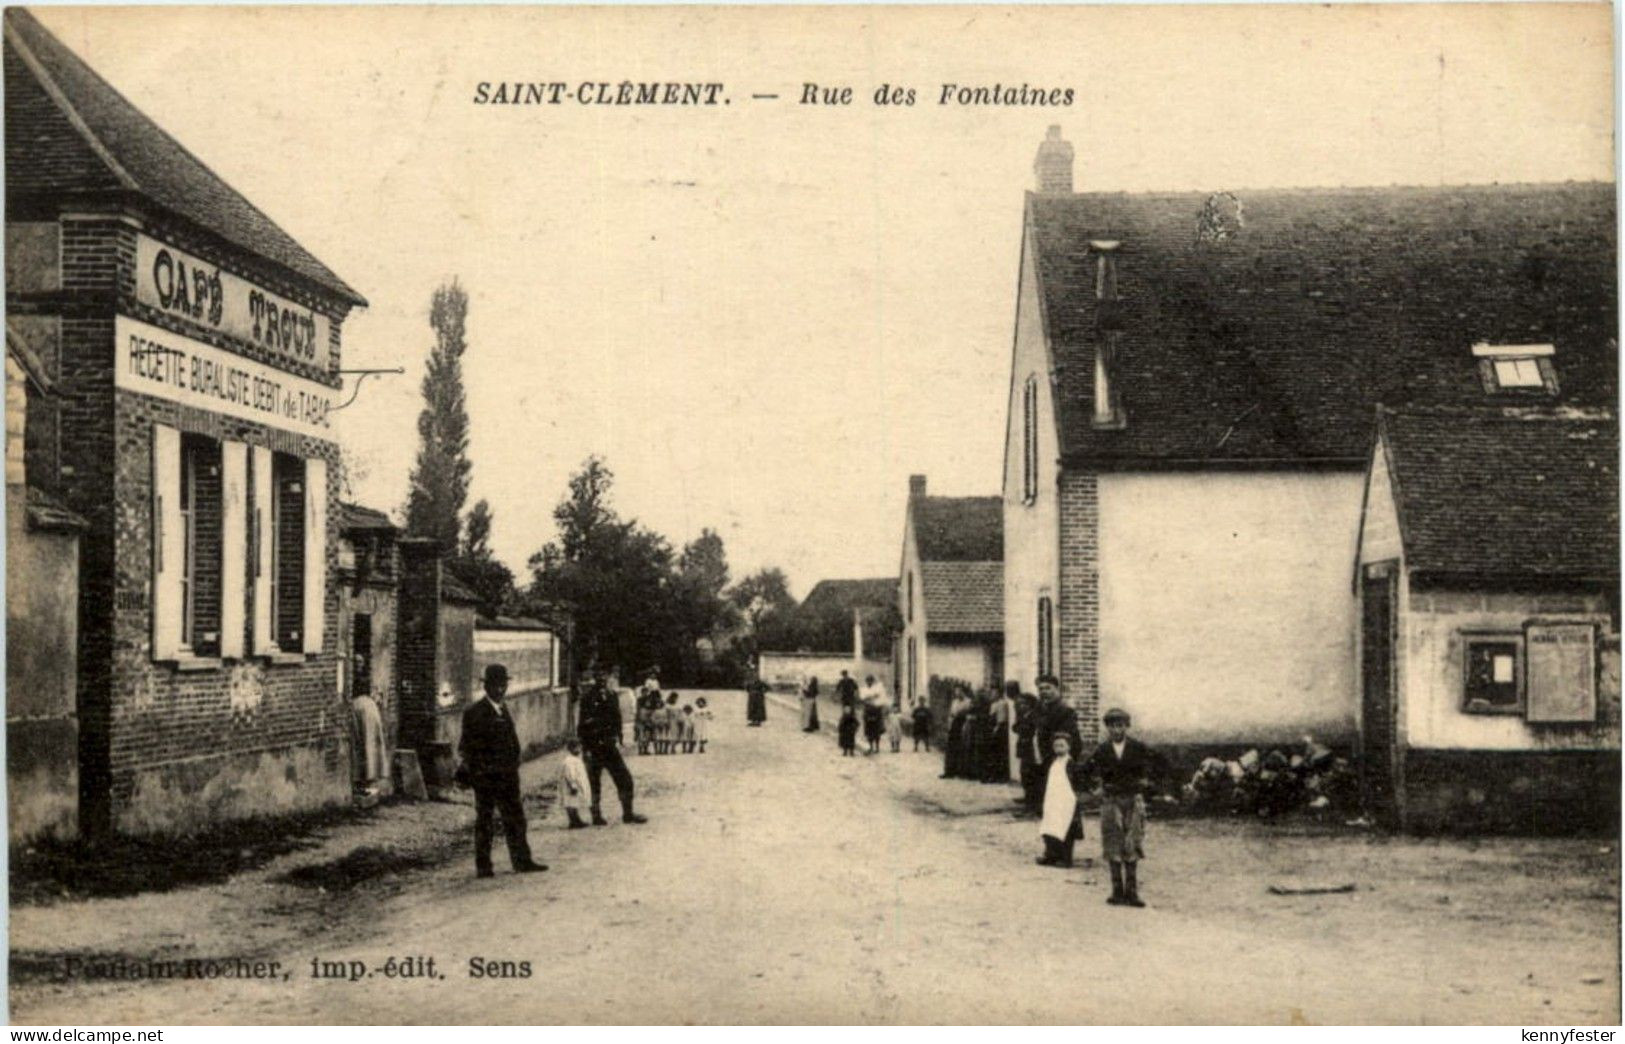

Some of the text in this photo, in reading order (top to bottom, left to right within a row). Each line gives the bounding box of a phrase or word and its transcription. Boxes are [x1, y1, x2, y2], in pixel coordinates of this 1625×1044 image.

[153, 248, 316, 360] CAFÉ TROUÉ
[128, 334, 331, 429] RECETTE BURALISTE DÉBIT de TABAC
